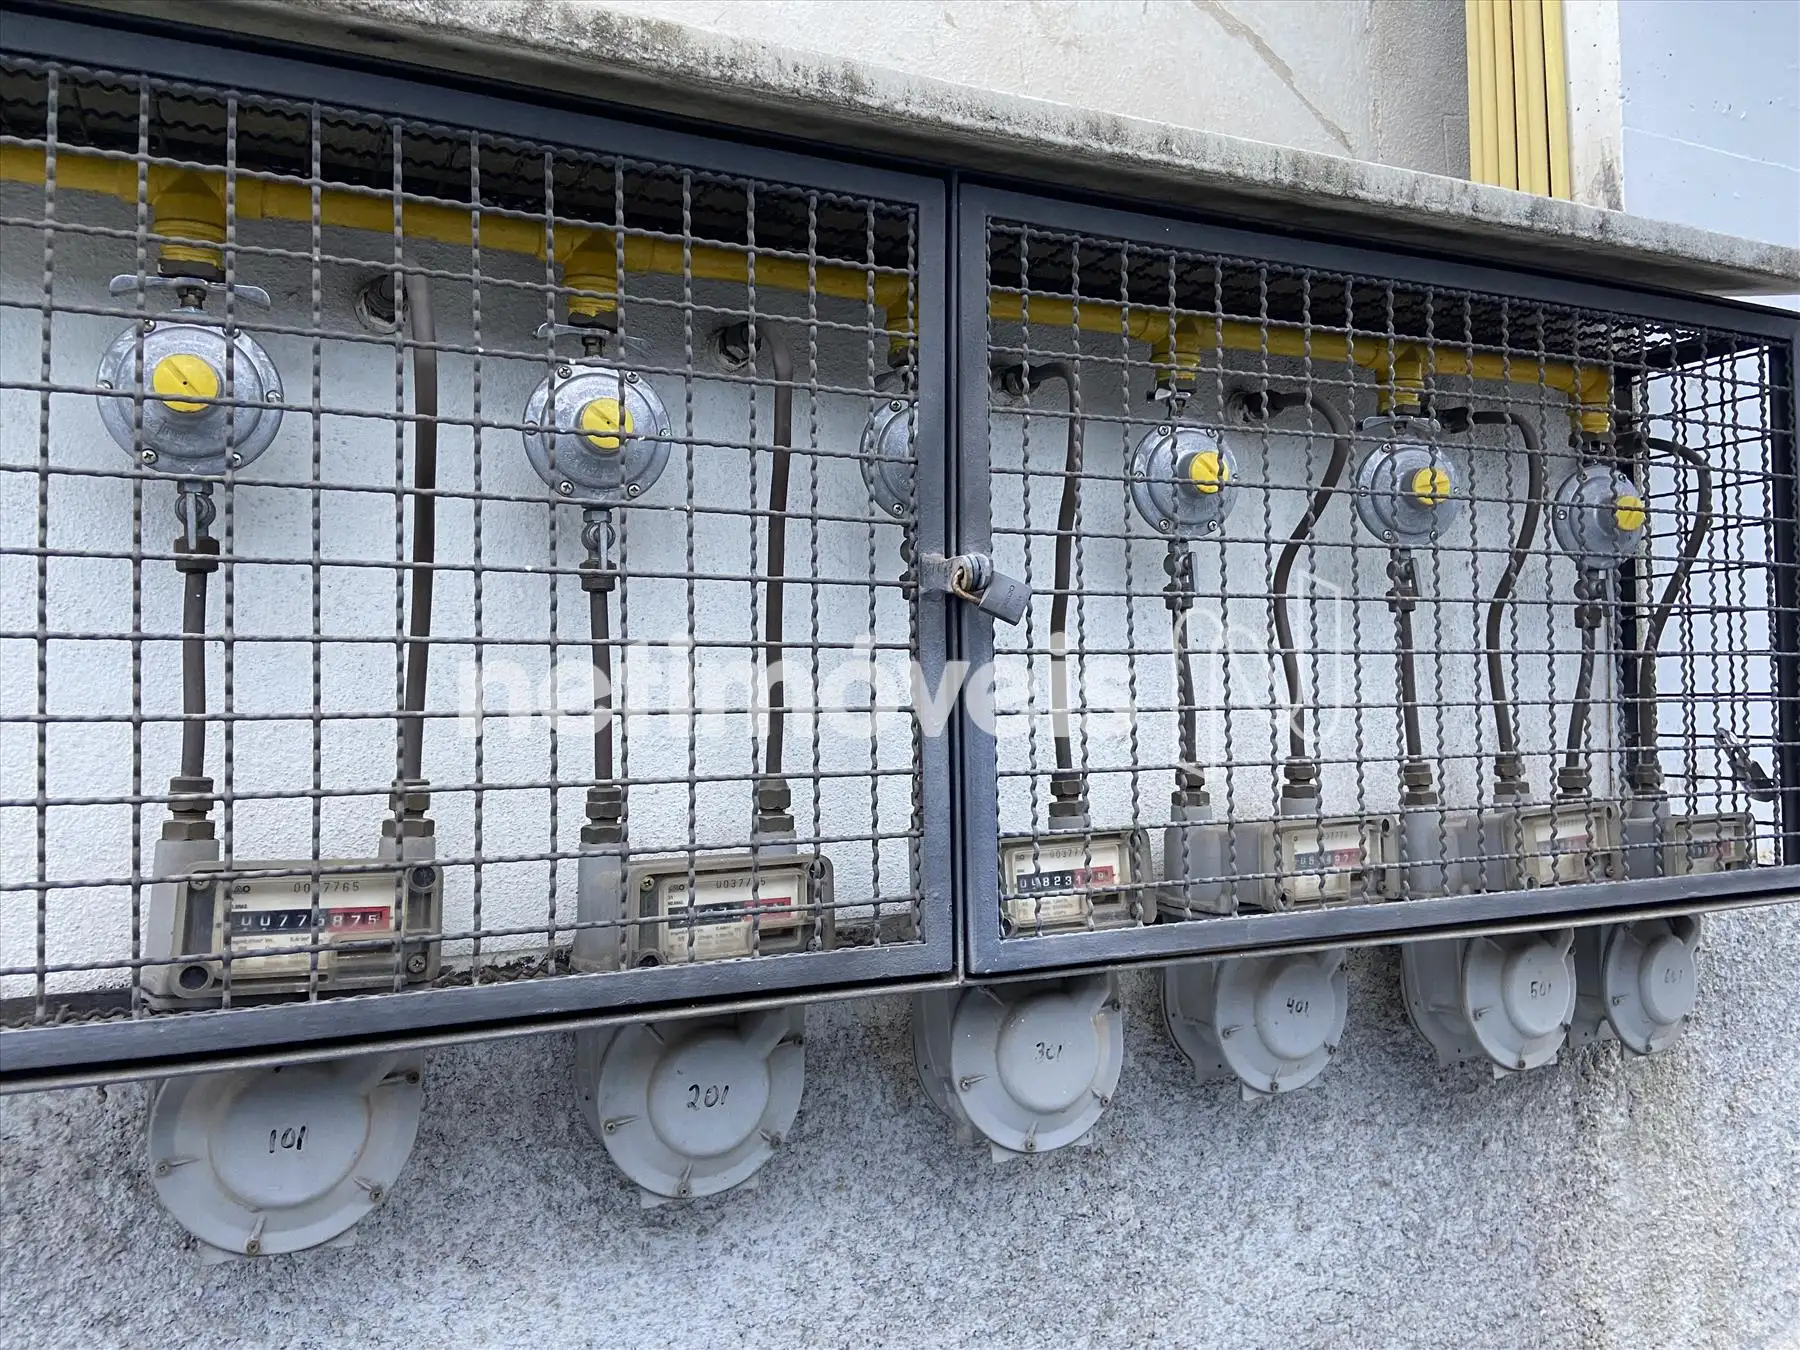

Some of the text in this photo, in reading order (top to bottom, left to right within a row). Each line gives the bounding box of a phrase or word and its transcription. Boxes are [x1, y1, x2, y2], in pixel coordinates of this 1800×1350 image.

[293, 881, 360, 893] 007765
[716, 876, 767, 889] 003775
[1286, 995, 1310, 1016] 401
[1035, 1041, 1063, 1063] 301
[686, 1083, 730, 1110] 201
[269, 1125, 307, 1153] 101
